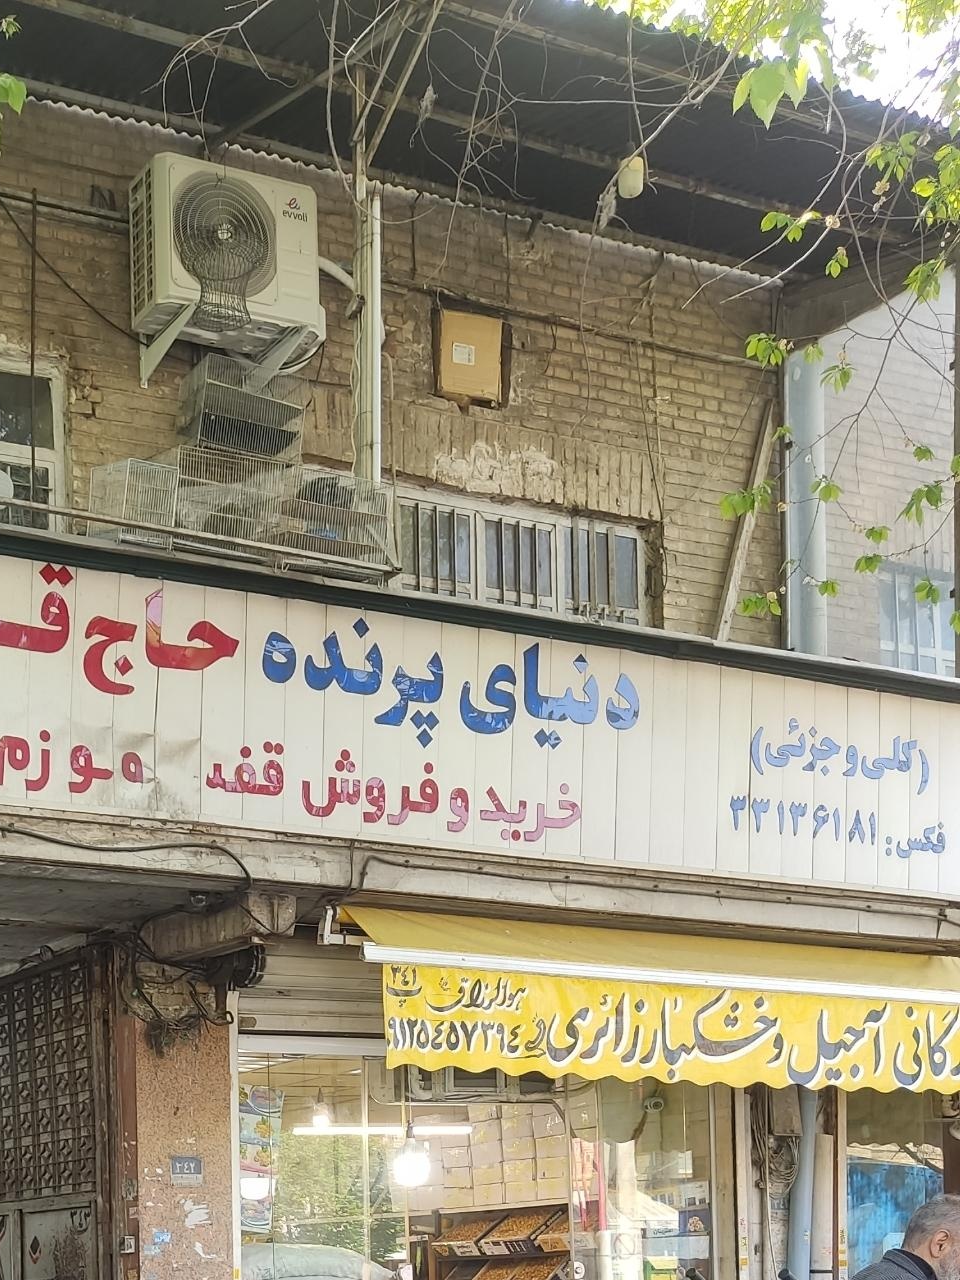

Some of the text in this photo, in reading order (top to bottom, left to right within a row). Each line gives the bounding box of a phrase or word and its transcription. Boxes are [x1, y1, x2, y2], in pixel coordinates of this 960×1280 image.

[83, 587, 240, 695] حاج
[262, 617, 444, 748] پرنده
[460, 643, 640, 749] دنیای
[301, 749, 440, 824] فروش
[448, 786, 470, 833] و
[479, 783, 582, 842] خرید
[729, 794, 877, 846] ۳۳۱۳۶۱۸۱
[787, 1001, 888, 1086] آجیل
